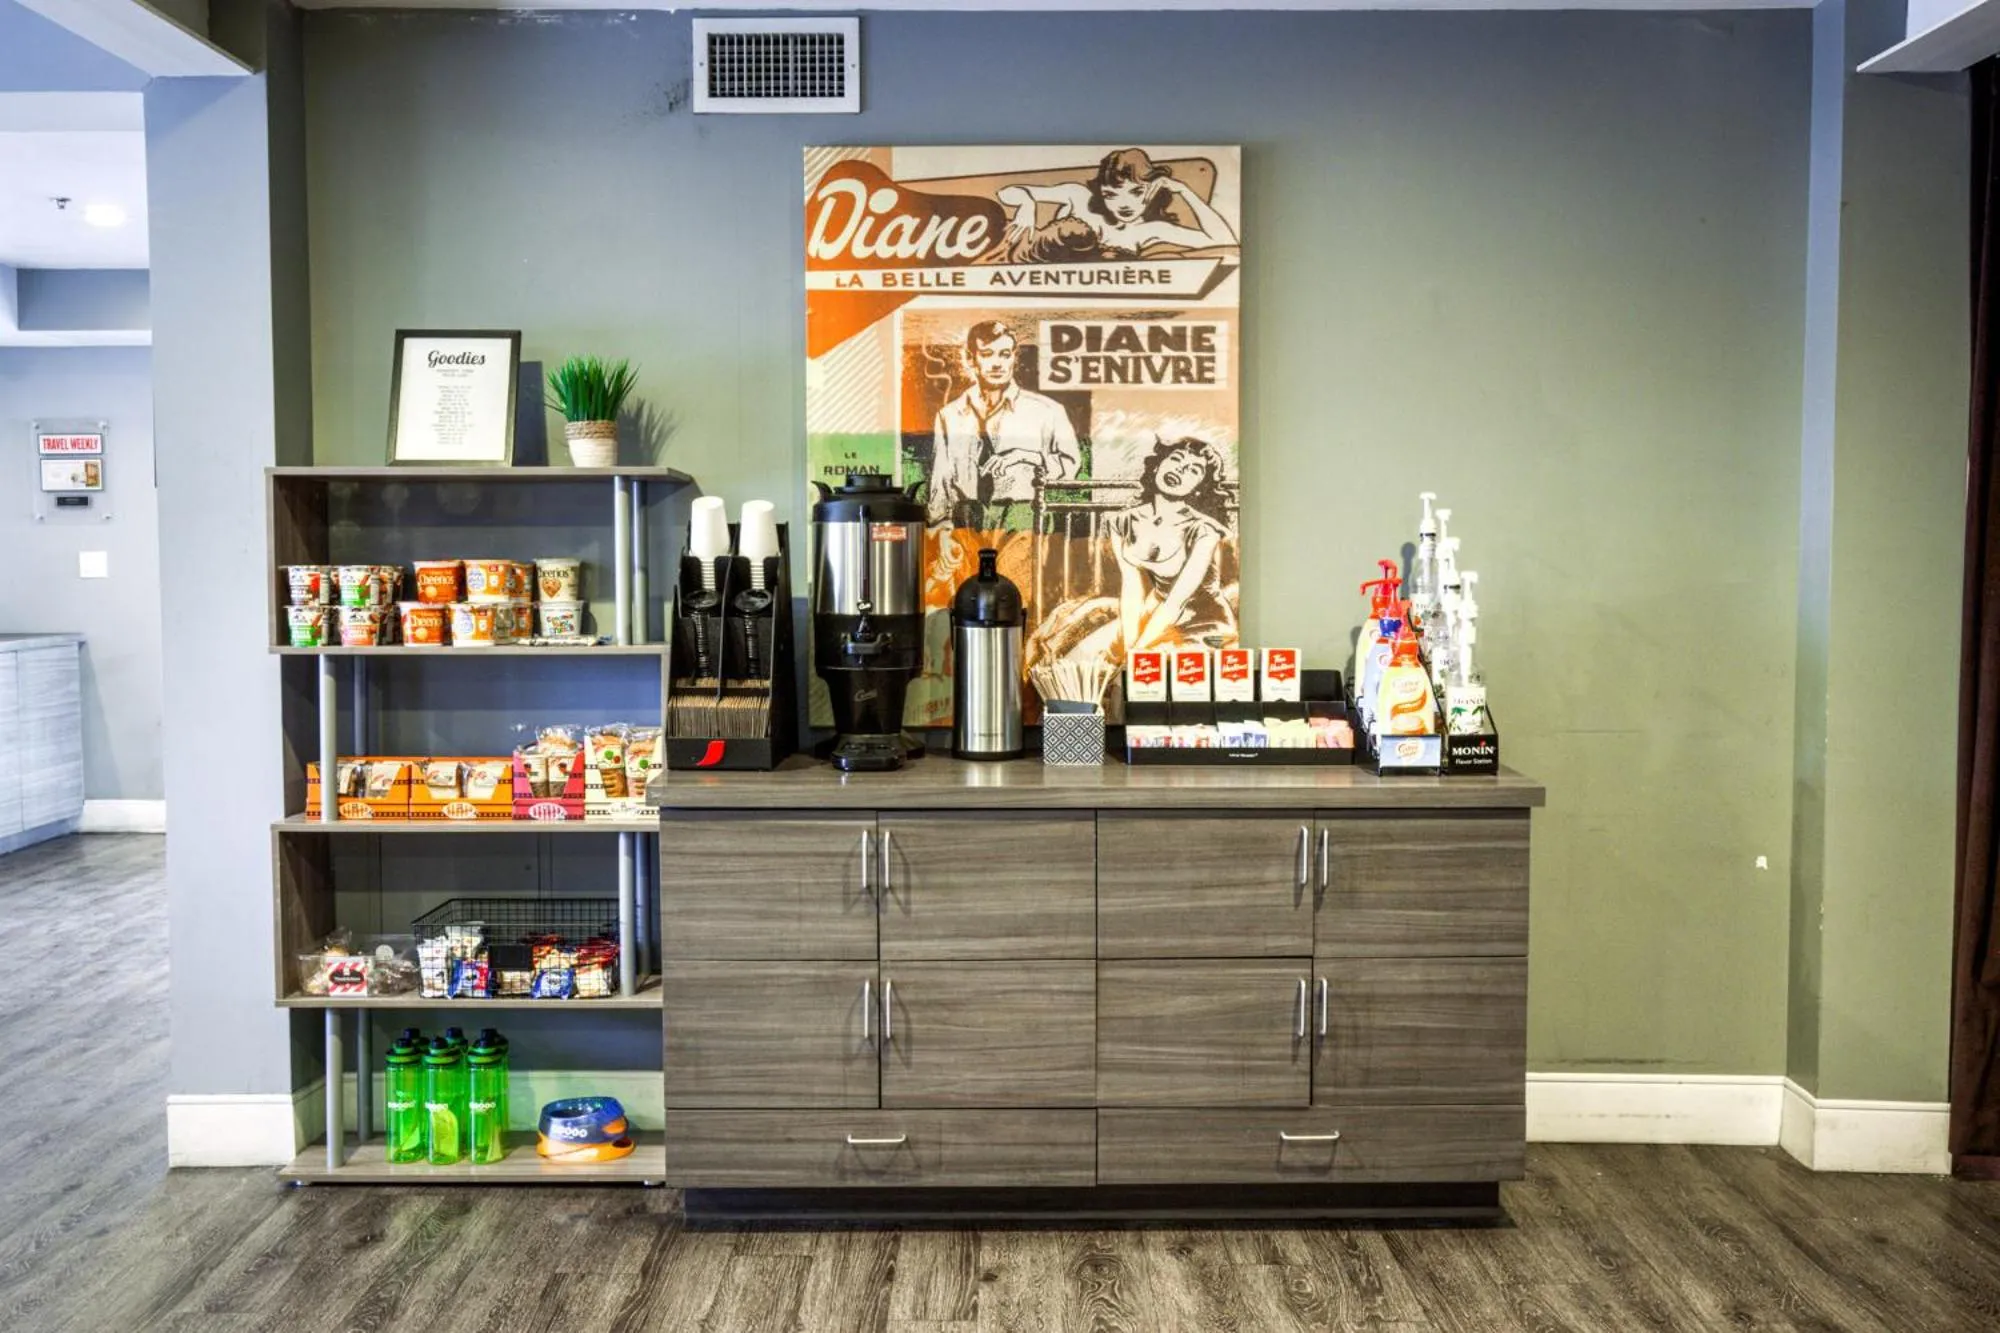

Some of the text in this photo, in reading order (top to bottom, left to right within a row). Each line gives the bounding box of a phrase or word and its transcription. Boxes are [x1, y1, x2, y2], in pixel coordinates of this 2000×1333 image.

[808, 178, 991, 260] Diane
[835, 266, 1173, 288] LA BELLE AVENTURIÈRE
[1048, 324, 1217, 353] DIANE
[427, 349, 487, 369] Goodies
[1047, 354, 1217, 385] S'ENIVRE
[43, 437, 98, 450] TRAVEL WEEKLY
[823, 465, 880, 475] ROMAN
[1452, 743, 1495, 755] MONIN
